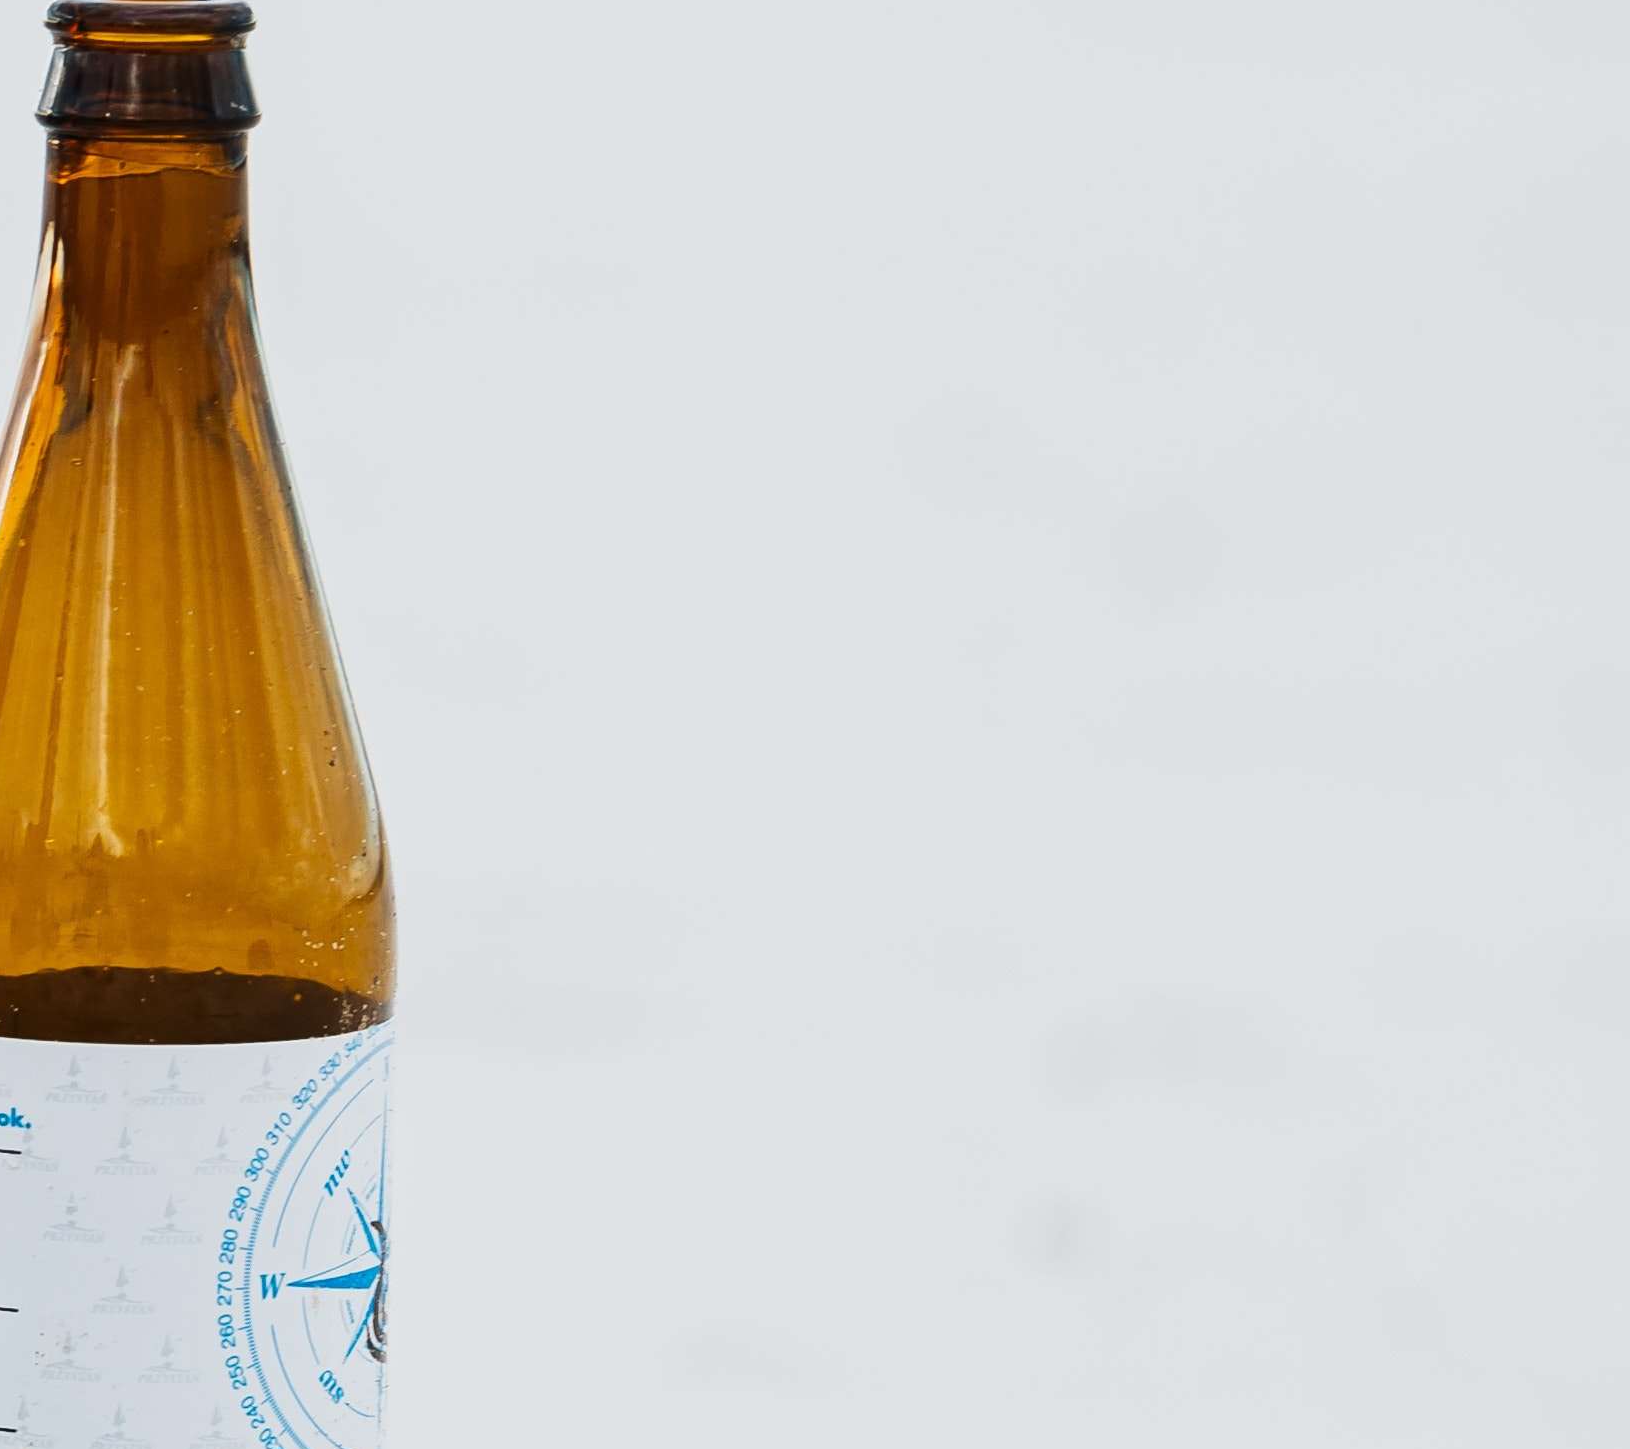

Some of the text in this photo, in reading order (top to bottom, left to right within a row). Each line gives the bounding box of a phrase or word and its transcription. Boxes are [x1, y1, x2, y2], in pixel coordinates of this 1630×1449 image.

[292, 1079, 318, 1111] 320
[266, 1112, 292, 1146] 310
[244, 1147, 270, 1183] 300
[229, 1185, 252, 1222] 290
[219, 1229, 238, 1265] 280
[216, 1270, 234, 1307] 270
[260, 1272, 286, 1300] W
[217, 1314, 237, 1349] 260
[225, 1355, 248, 1390] 250
[241, 1396, 265, 1429] 240
